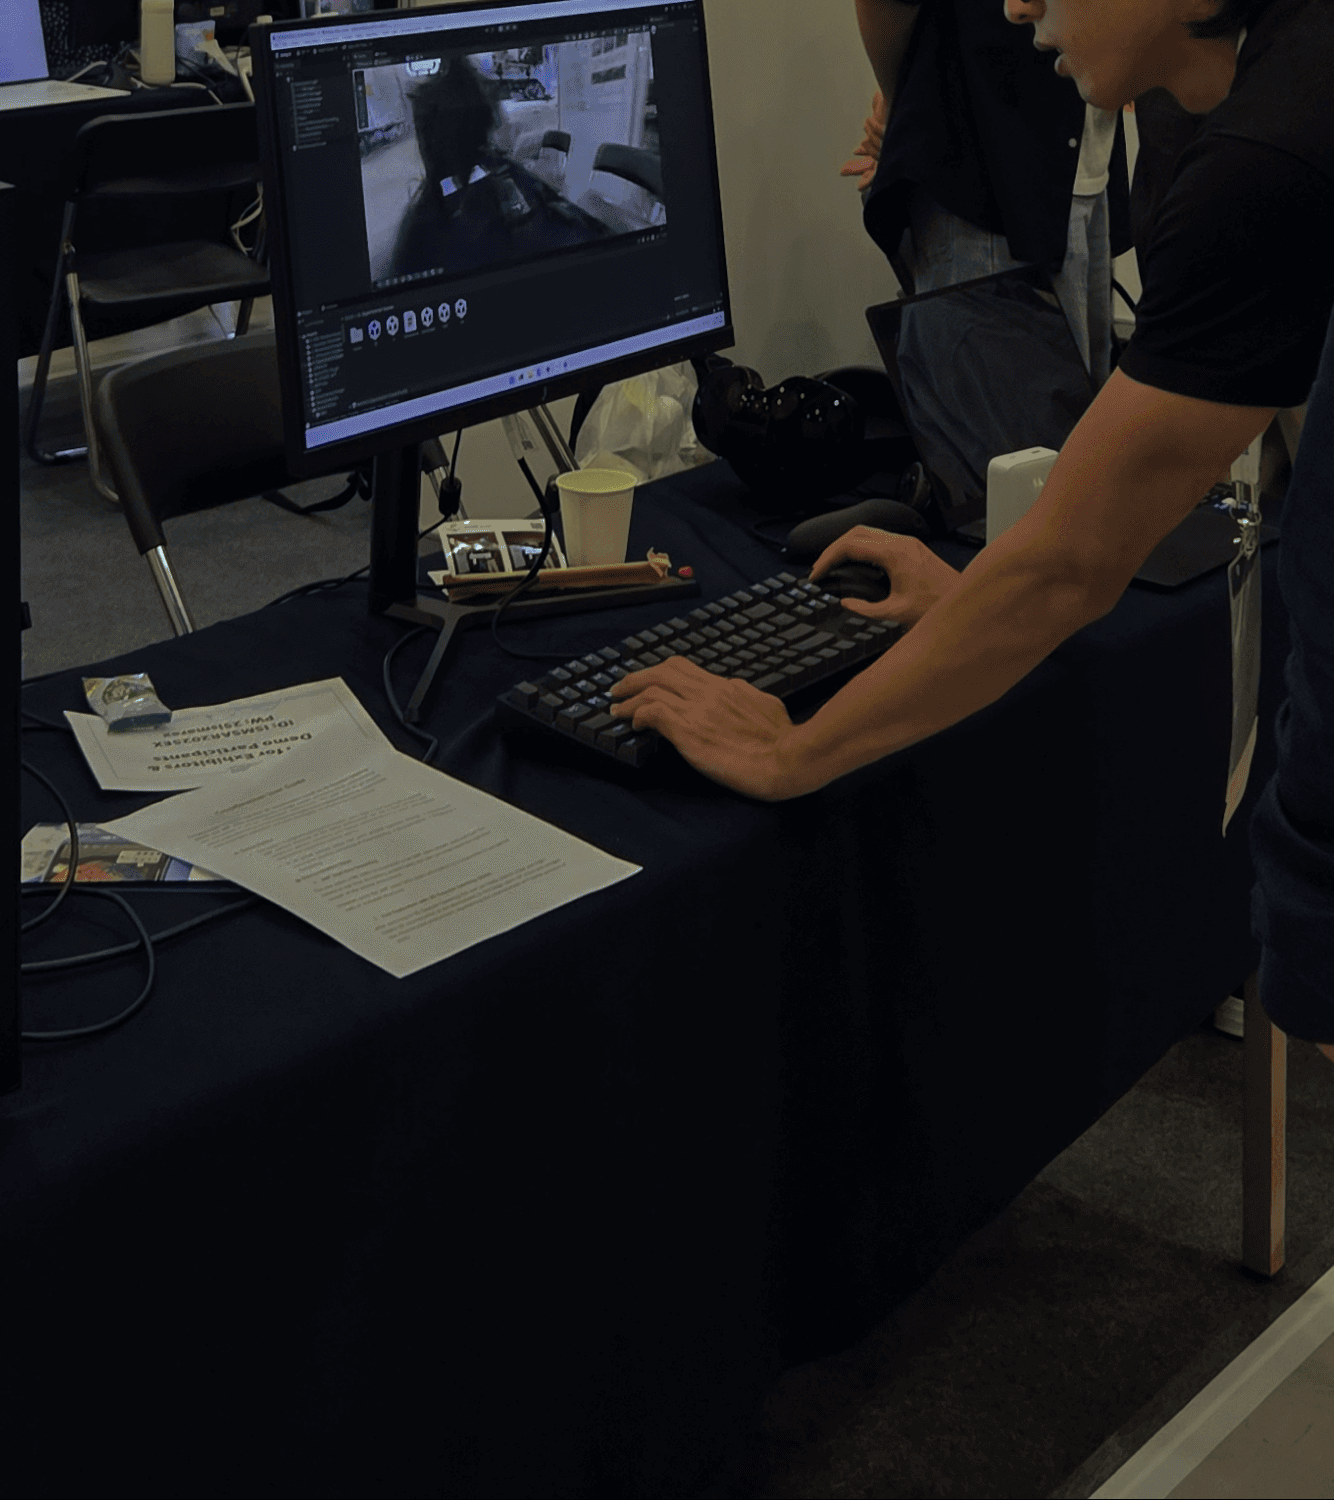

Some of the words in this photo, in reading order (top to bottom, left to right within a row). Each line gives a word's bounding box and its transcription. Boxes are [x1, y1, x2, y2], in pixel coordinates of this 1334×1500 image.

[263, 733, 312, 746] Demo
[153, 743, 259, 761] Participants
[164, 754, 255, 770] Exhibitors
